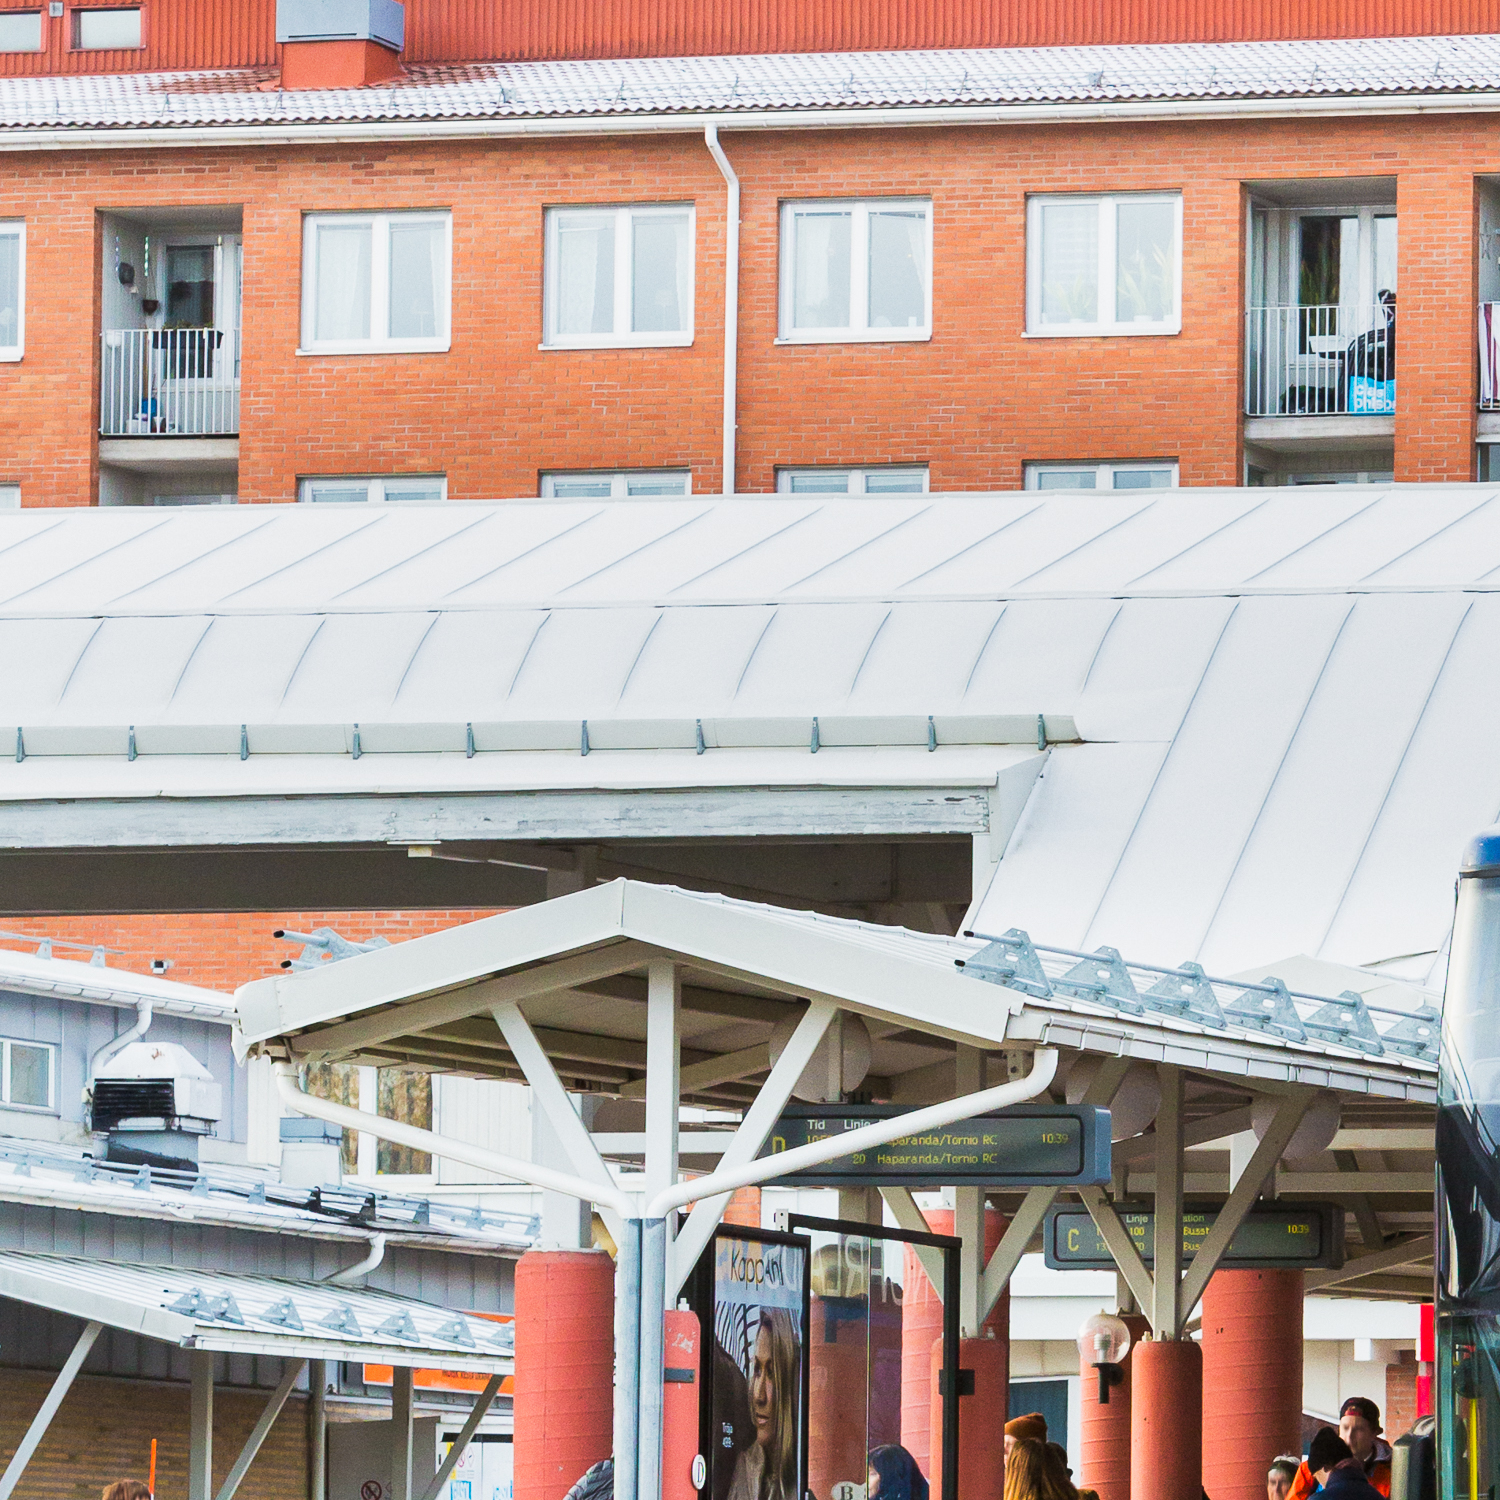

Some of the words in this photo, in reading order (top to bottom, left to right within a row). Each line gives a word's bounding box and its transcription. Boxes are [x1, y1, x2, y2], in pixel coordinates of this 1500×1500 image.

[807, 1119, 826, 1130] Tid
[1126, 1214, 1149, 1225] Linje
[1067, 1228, 1080, 1252] C
[696, 1461, 705, 1483] D
[839, 1486, 854, 1500] B
